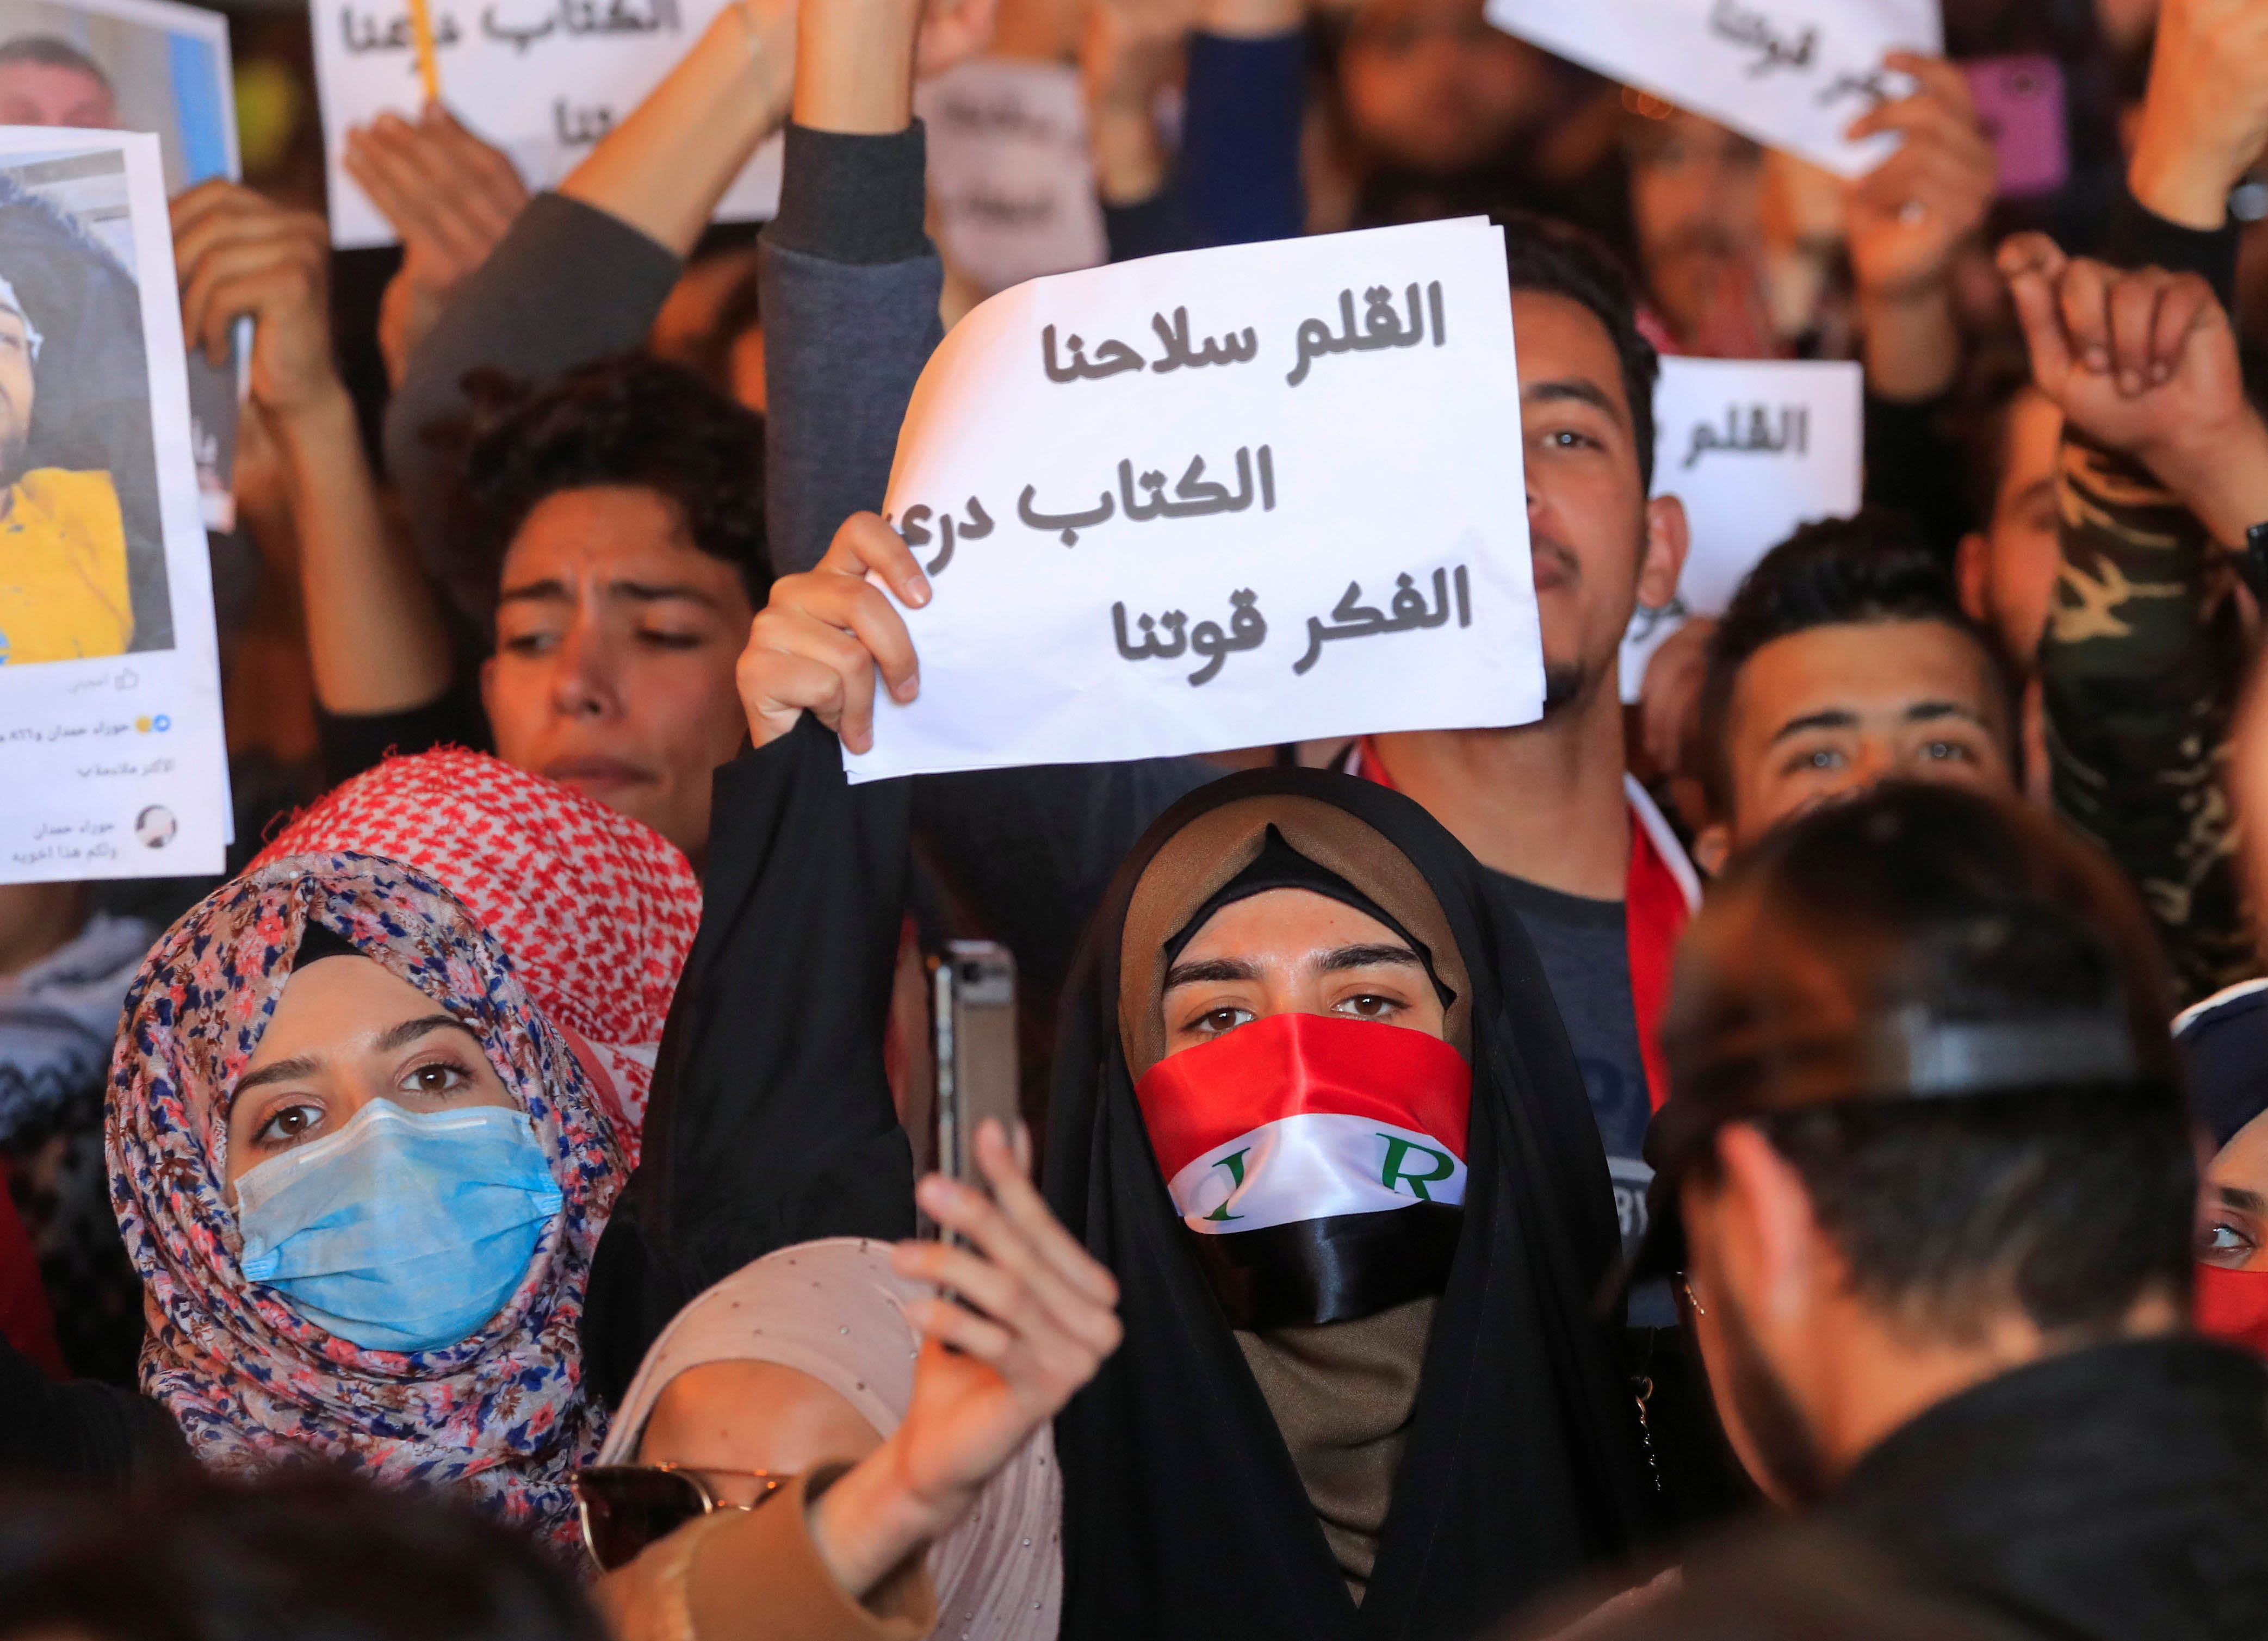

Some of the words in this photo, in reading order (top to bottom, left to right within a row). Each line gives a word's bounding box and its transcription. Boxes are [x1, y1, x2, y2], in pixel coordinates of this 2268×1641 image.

[342, 4, 460, 74] دعنا
[1041, 306, 1257, 384] سلاحنا
[1286, 280, 1446, 388] القلم
[1682, 403, 1809, 469] القلم
[885, 495, 995, 576] درع
[1017, 444, 1275, 548] الكتاب
[1112, 586, 1268, 687] قوتنا
[1292, 564, 1472, 675] الفكر
